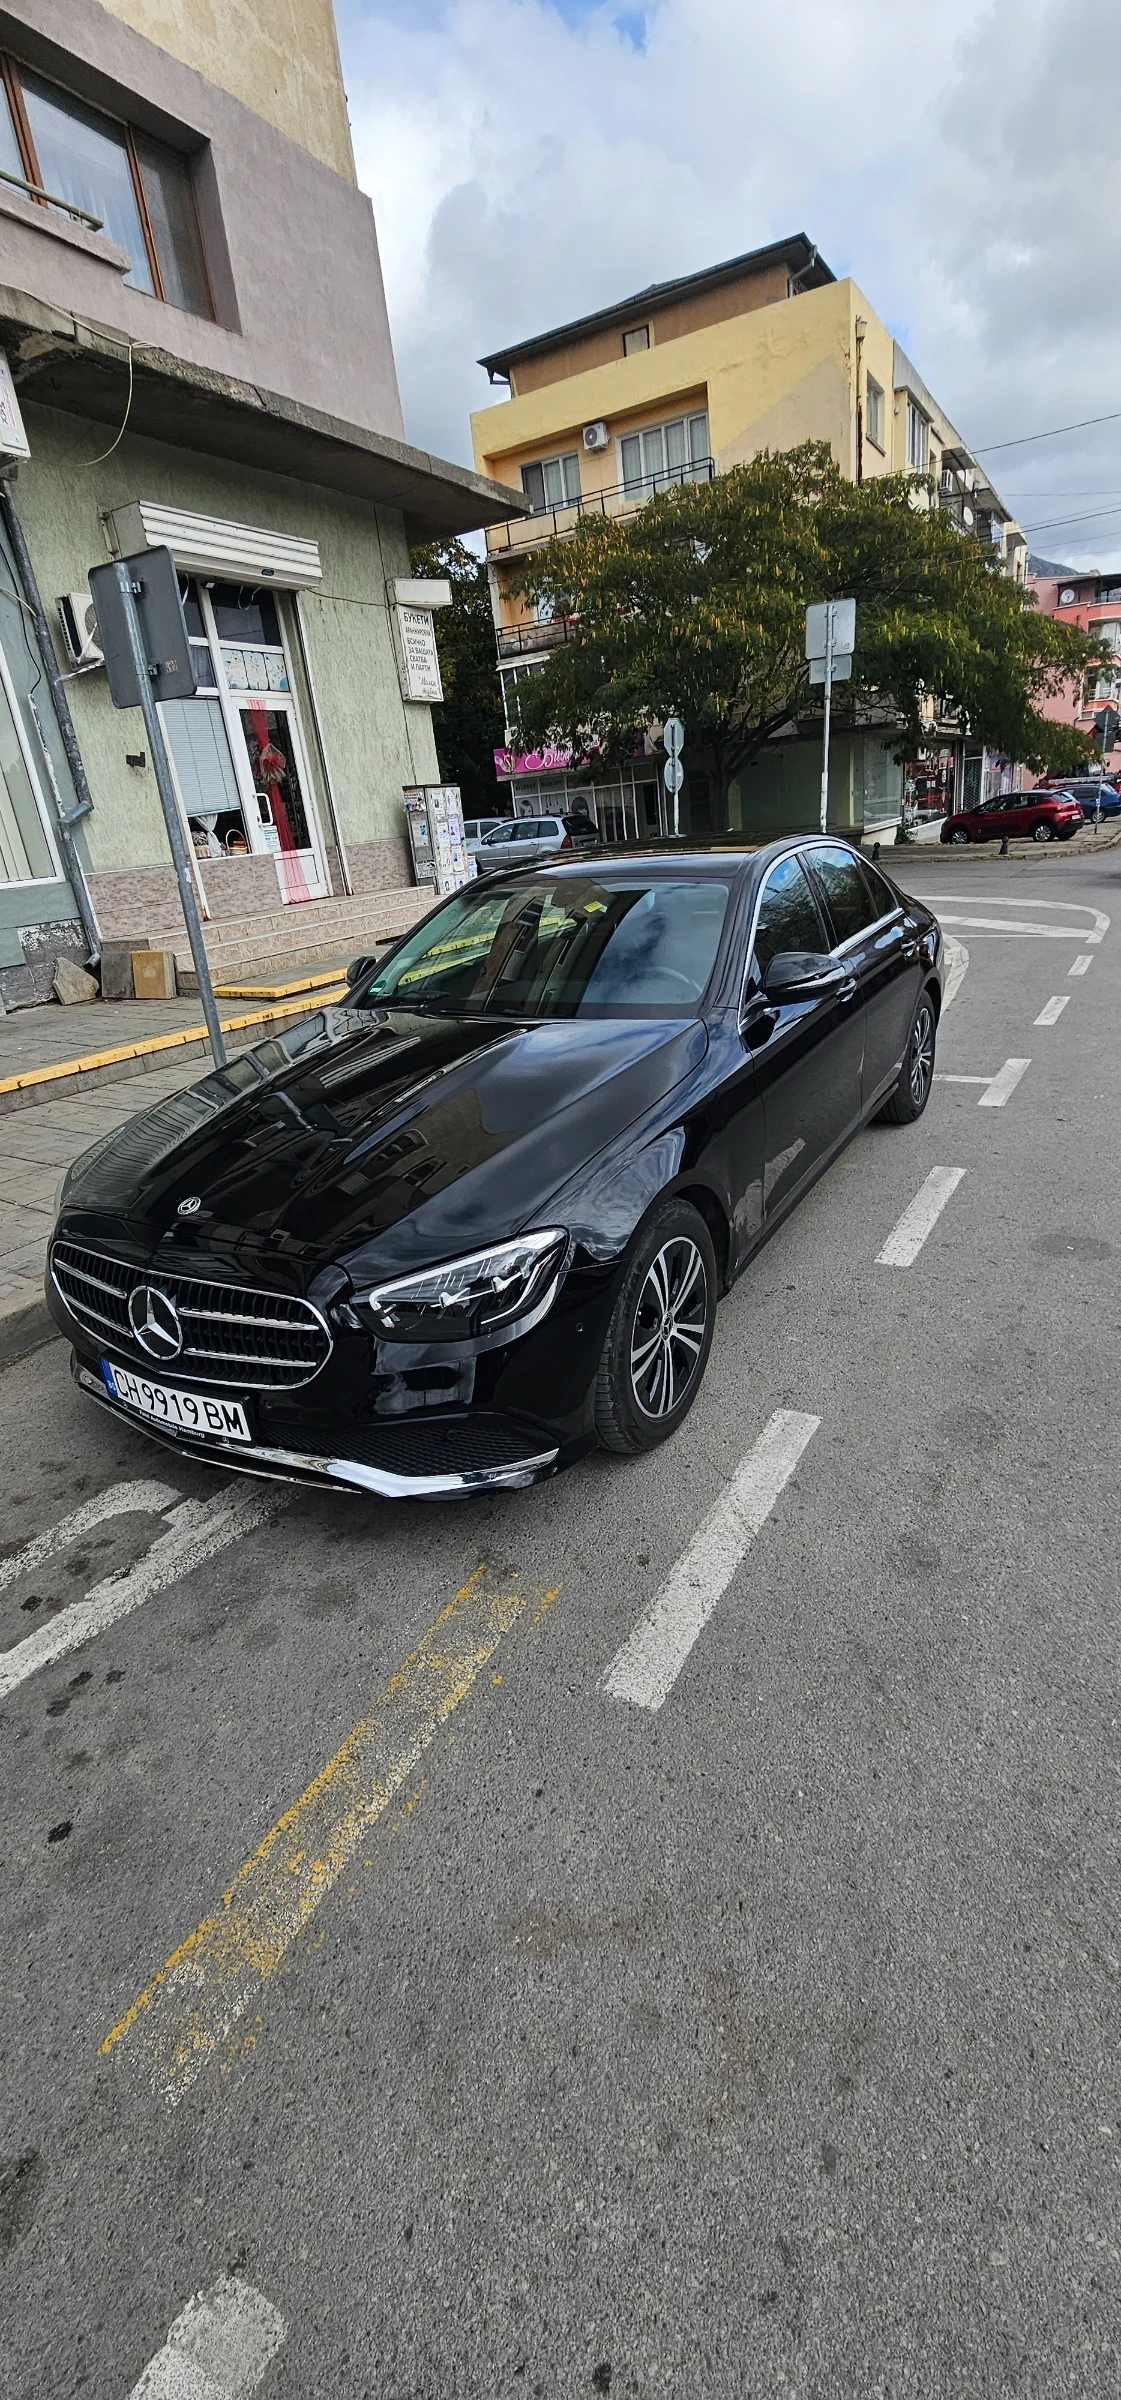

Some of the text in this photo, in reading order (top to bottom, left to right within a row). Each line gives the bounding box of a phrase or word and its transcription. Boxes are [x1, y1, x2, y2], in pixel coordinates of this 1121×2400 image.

[403, 612, 430, 625] БУКЕТИ
[406, 637, 426, 647] ВСИЧКО
[408, 646, 434, 656] ЗА ВАШАТА
[409, 655, 428, 664] СВАТБА
[178, 1426, 205, 1438] Hamburg
